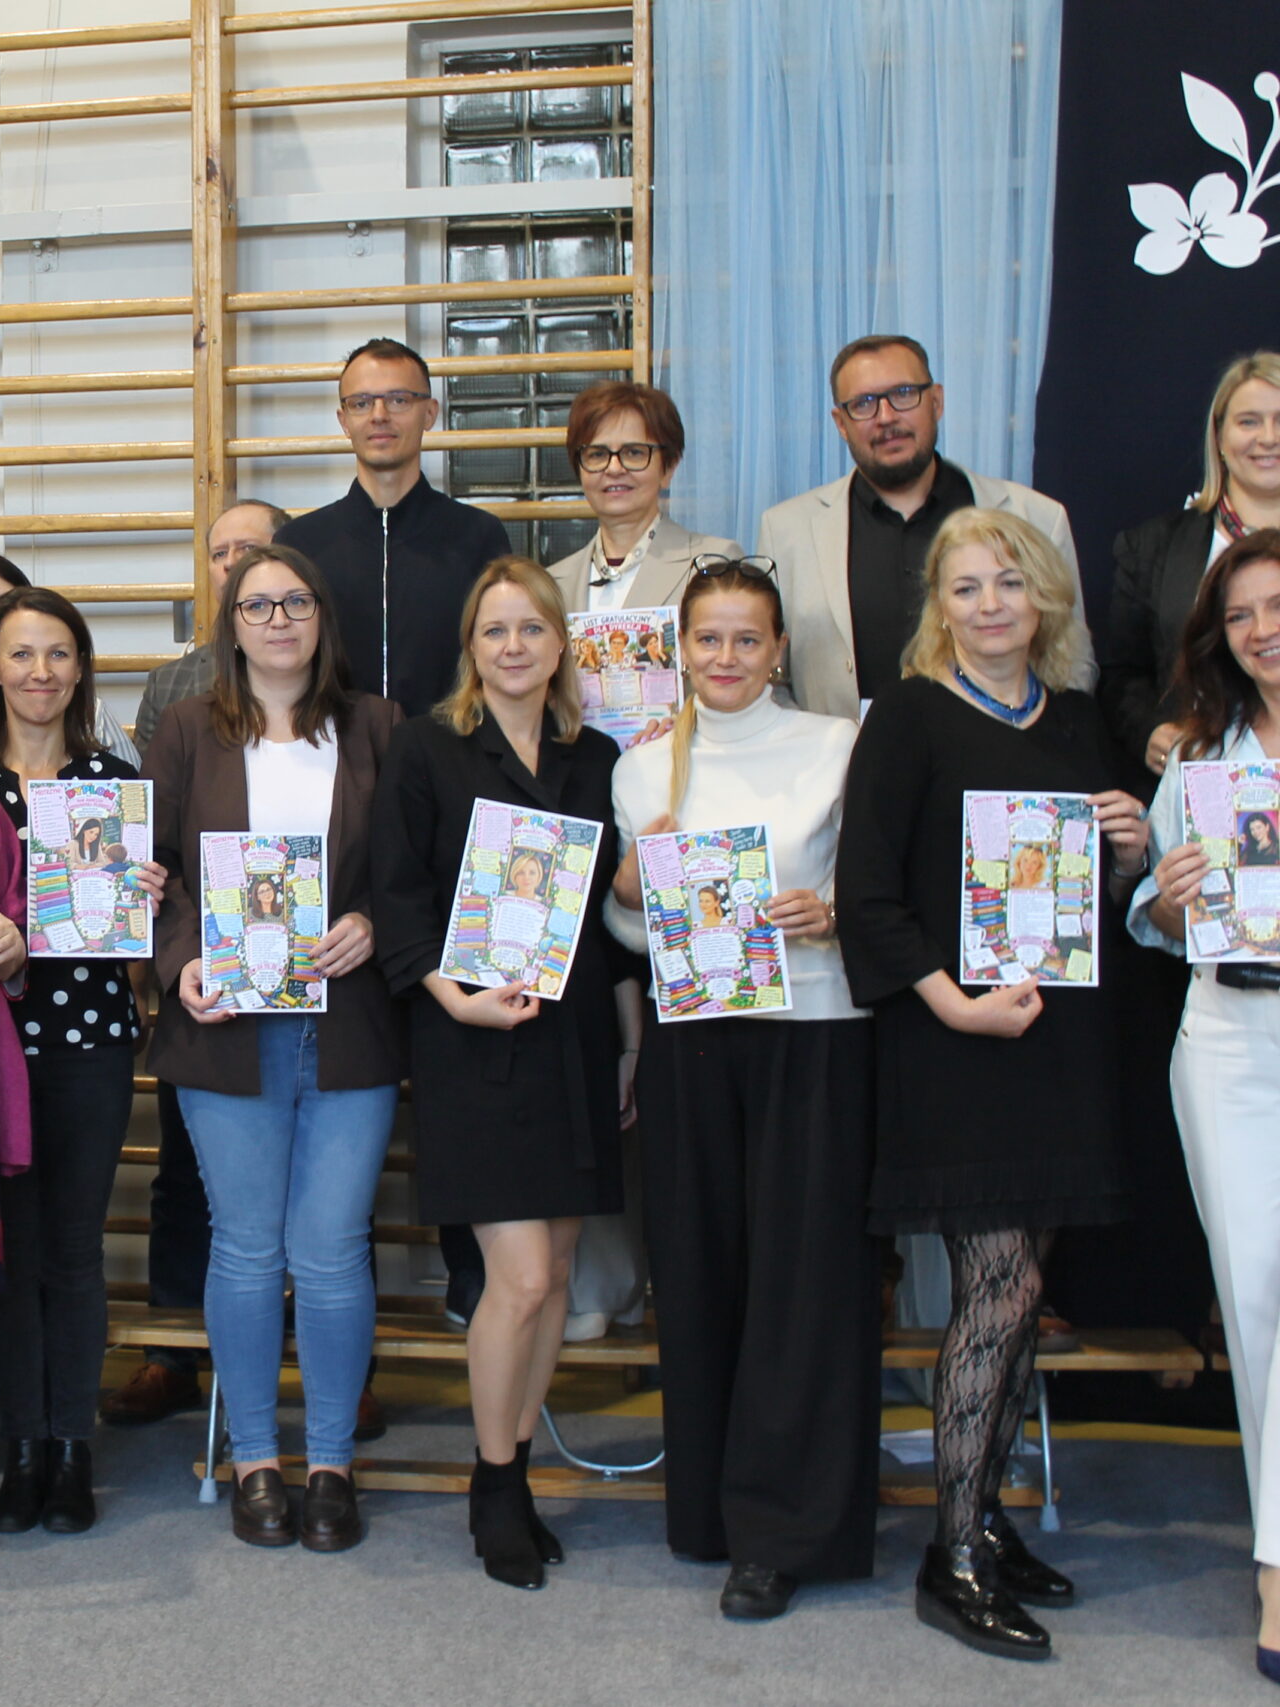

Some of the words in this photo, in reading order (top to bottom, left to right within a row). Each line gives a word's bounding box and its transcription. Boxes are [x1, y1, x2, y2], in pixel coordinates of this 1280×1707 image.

[583, 617, 598, 628] LIST
[601, 615, 651, 624] GRATULACYJNY
[594, 626, 607, 634] DLA
[609, 623, 641, 632] DYREKCJI
[65, 785, 116, 800] DYPLOM
[240, 838, 289, 853] DYPLOM
[678, 836, 733, 854] DYPLOM
